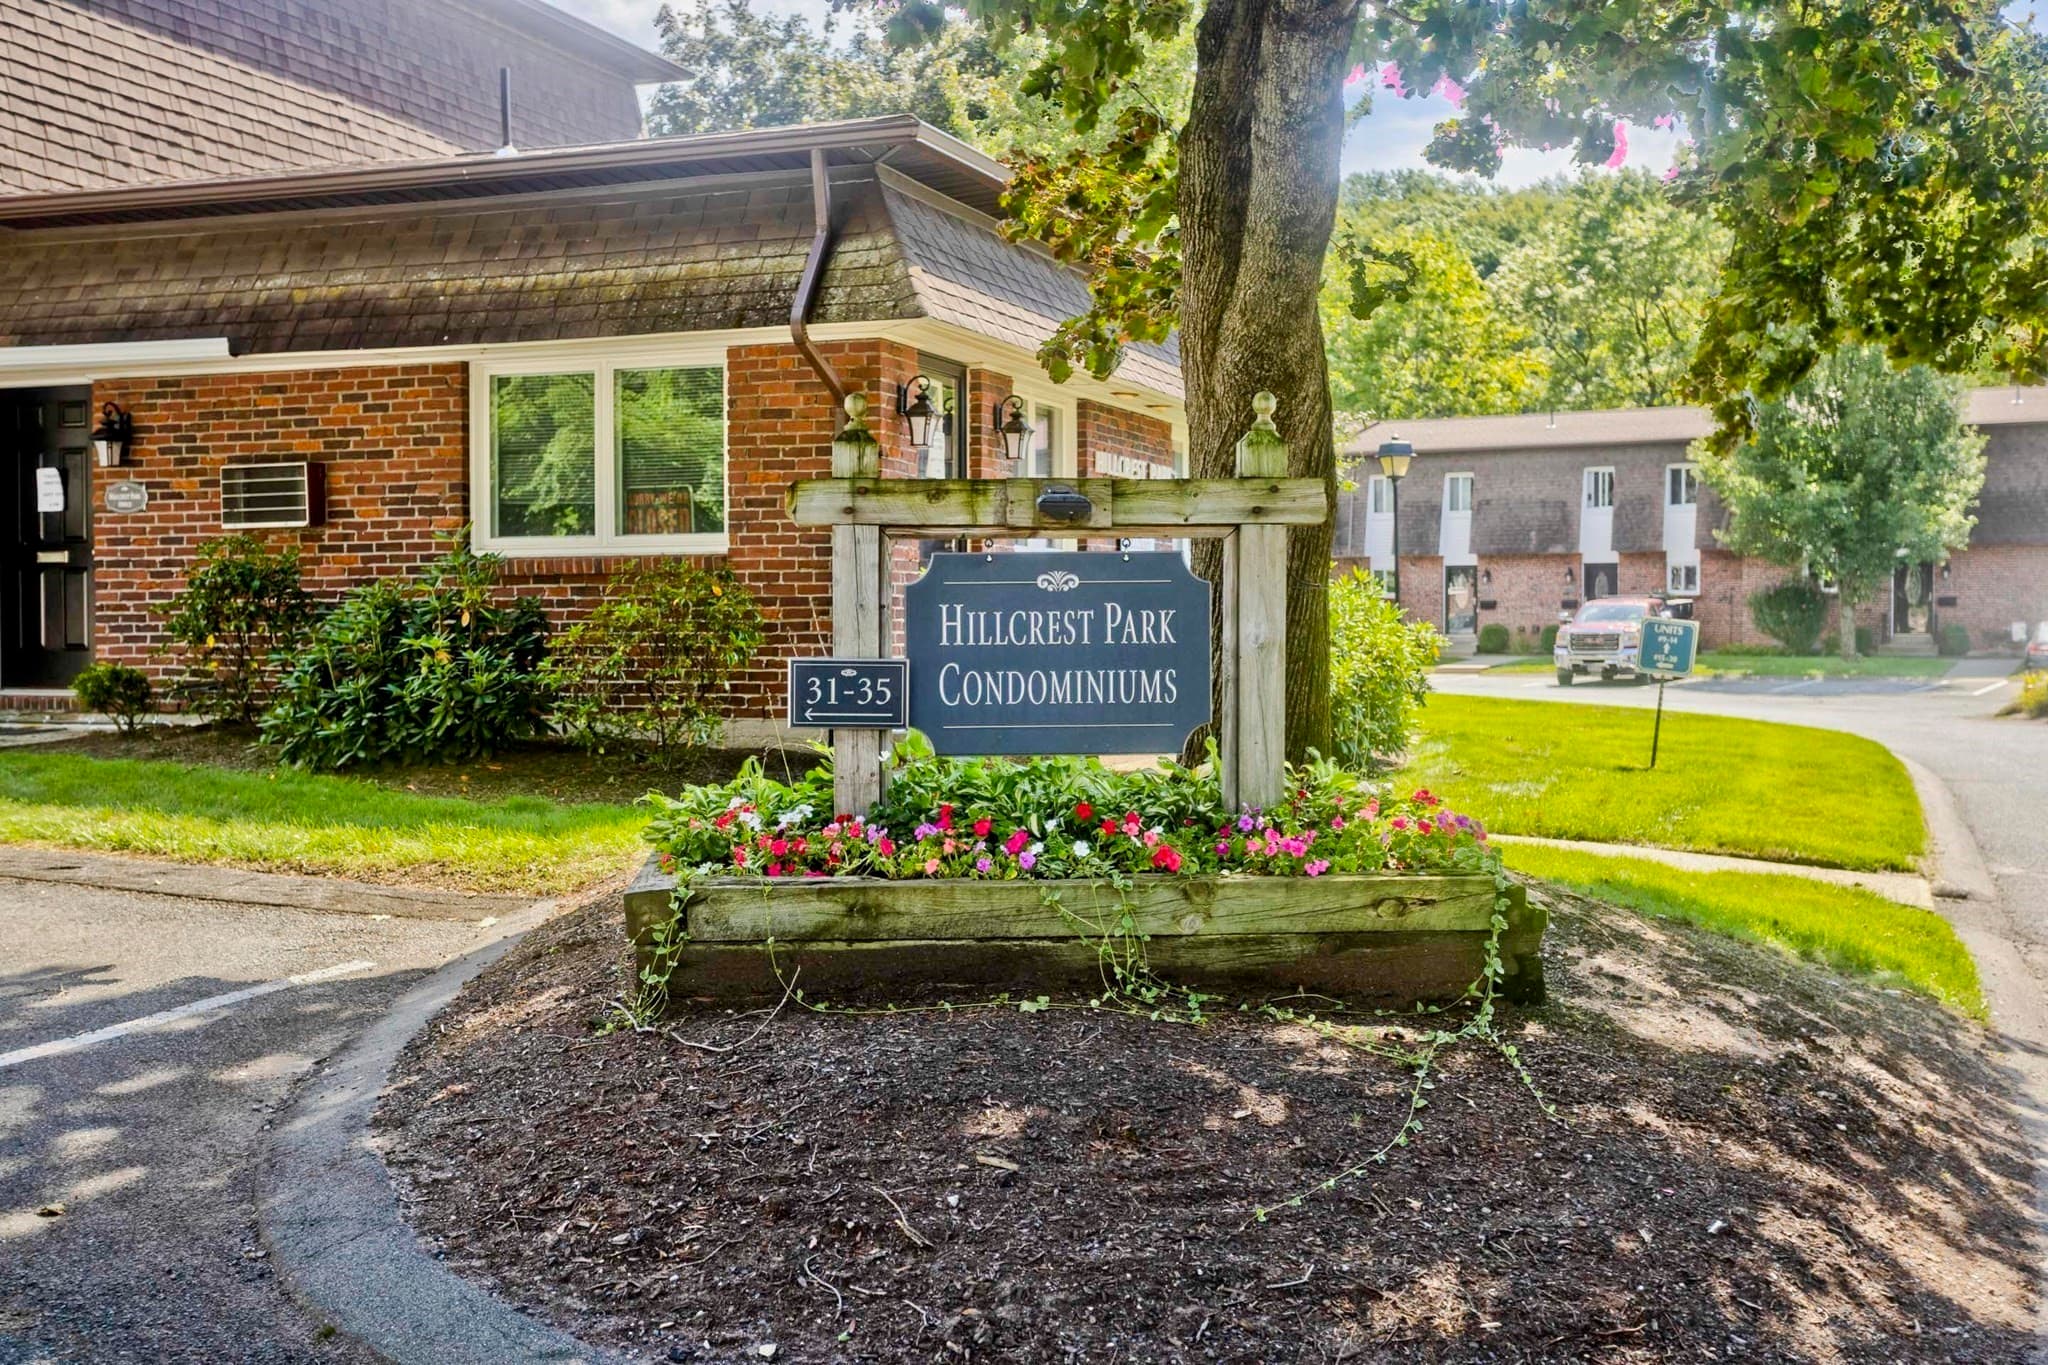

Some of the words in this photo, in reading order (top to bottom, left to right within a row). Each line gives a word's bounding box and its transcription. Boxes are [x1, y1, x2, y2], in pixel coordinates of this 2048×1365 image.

[939, 603, 1094, 647] HILLCREST
[1104, 602, 1177, 645] PARK
[1654, 623, 1684, 636] UNITS
[806, 677, 892, 706] 31-35
[938, 662, 1177, 706] CONDOMINIUMS
